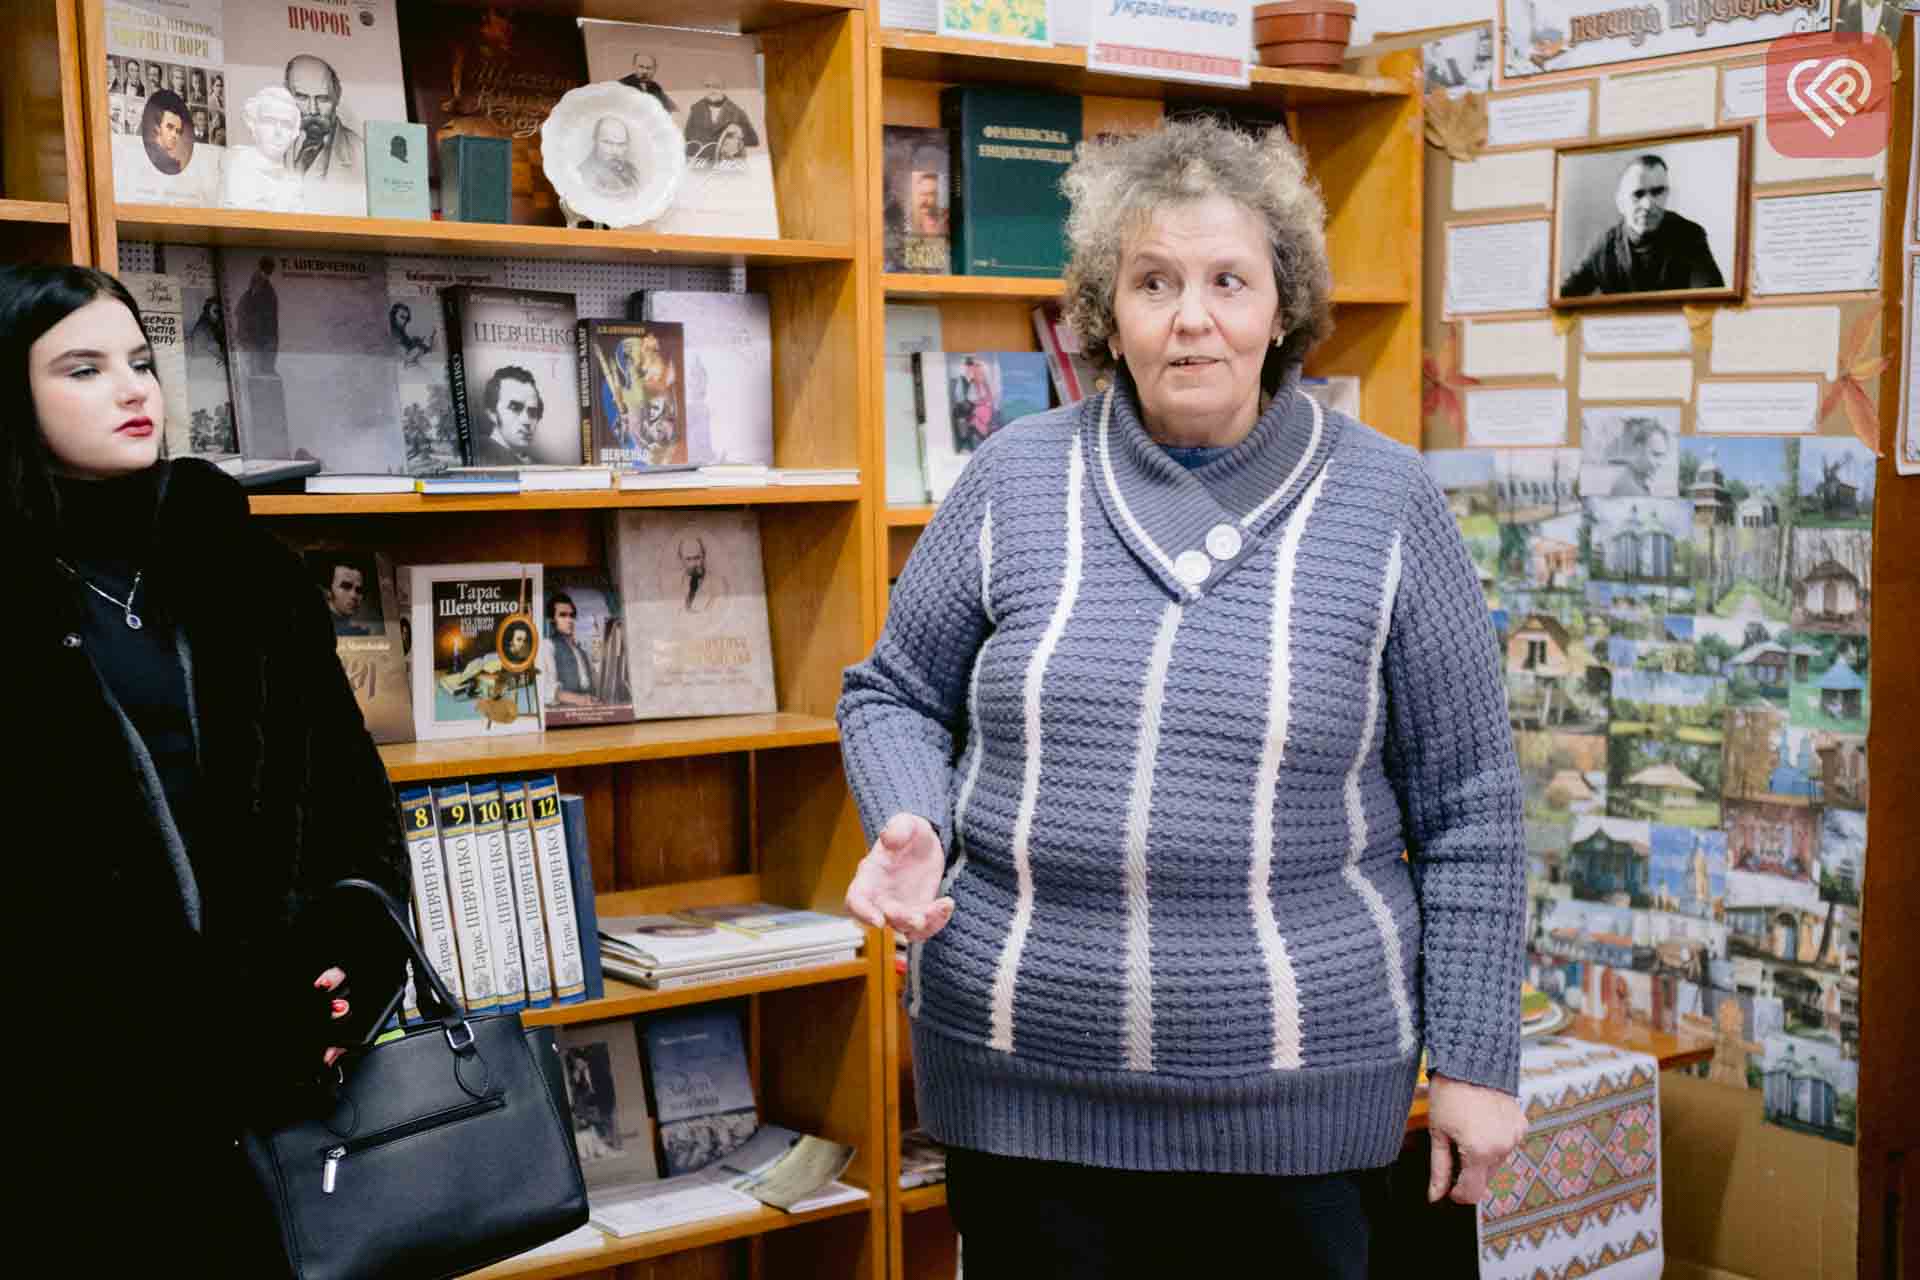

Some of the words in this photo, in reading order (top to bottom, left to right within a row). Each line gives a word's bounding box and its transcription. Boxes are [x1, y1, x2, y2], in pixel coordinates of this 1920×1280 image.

[288, 6, 352, 37] ПРОРОК
[457, 583, 501, 605] Тарас
[439, 599, 518, 616] Шевченко
[415, 806, 429, 829] 8
[451, 804, 465, 825] 9
[478, 802, 500, 824] 10
[508, 801, 527, 821] 11
[537, 796, 557, 818] 12
[417, 840, 442, 932] ШЕВЧЕНКО
[455, 837, 481, 928] ШЕВЧЕНКО
[488, 833, 513, 924] ШЕВЧЕНКО
